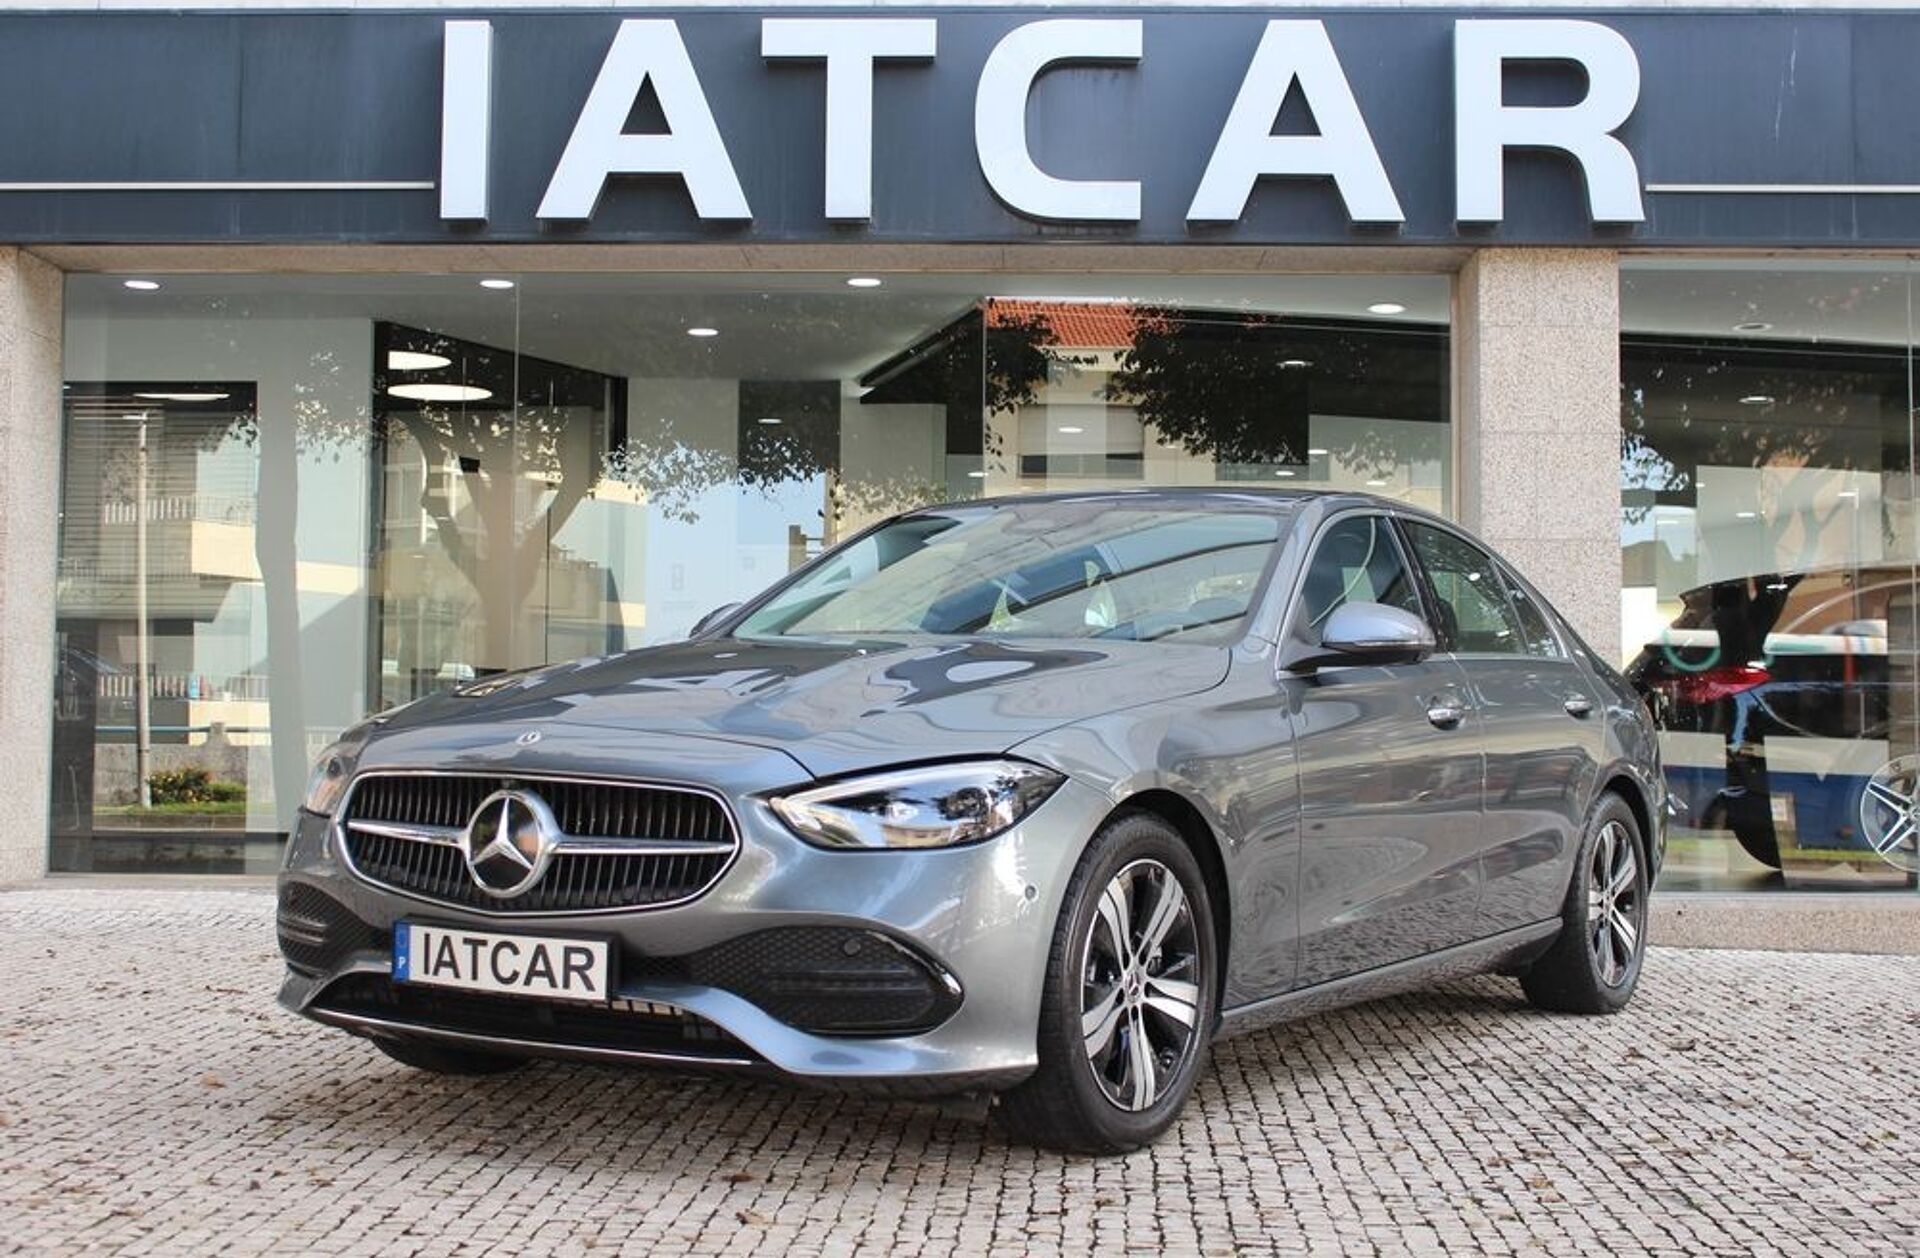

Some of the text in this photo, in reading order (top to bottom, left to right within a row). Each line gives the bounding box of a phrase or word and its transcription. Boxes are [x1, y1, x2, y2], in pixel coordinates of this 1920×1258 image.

[439, 18, 1645, 223] IATCAR
[398, 956, 406, 969] P
[423, 932, 596, 992] IATCAR
